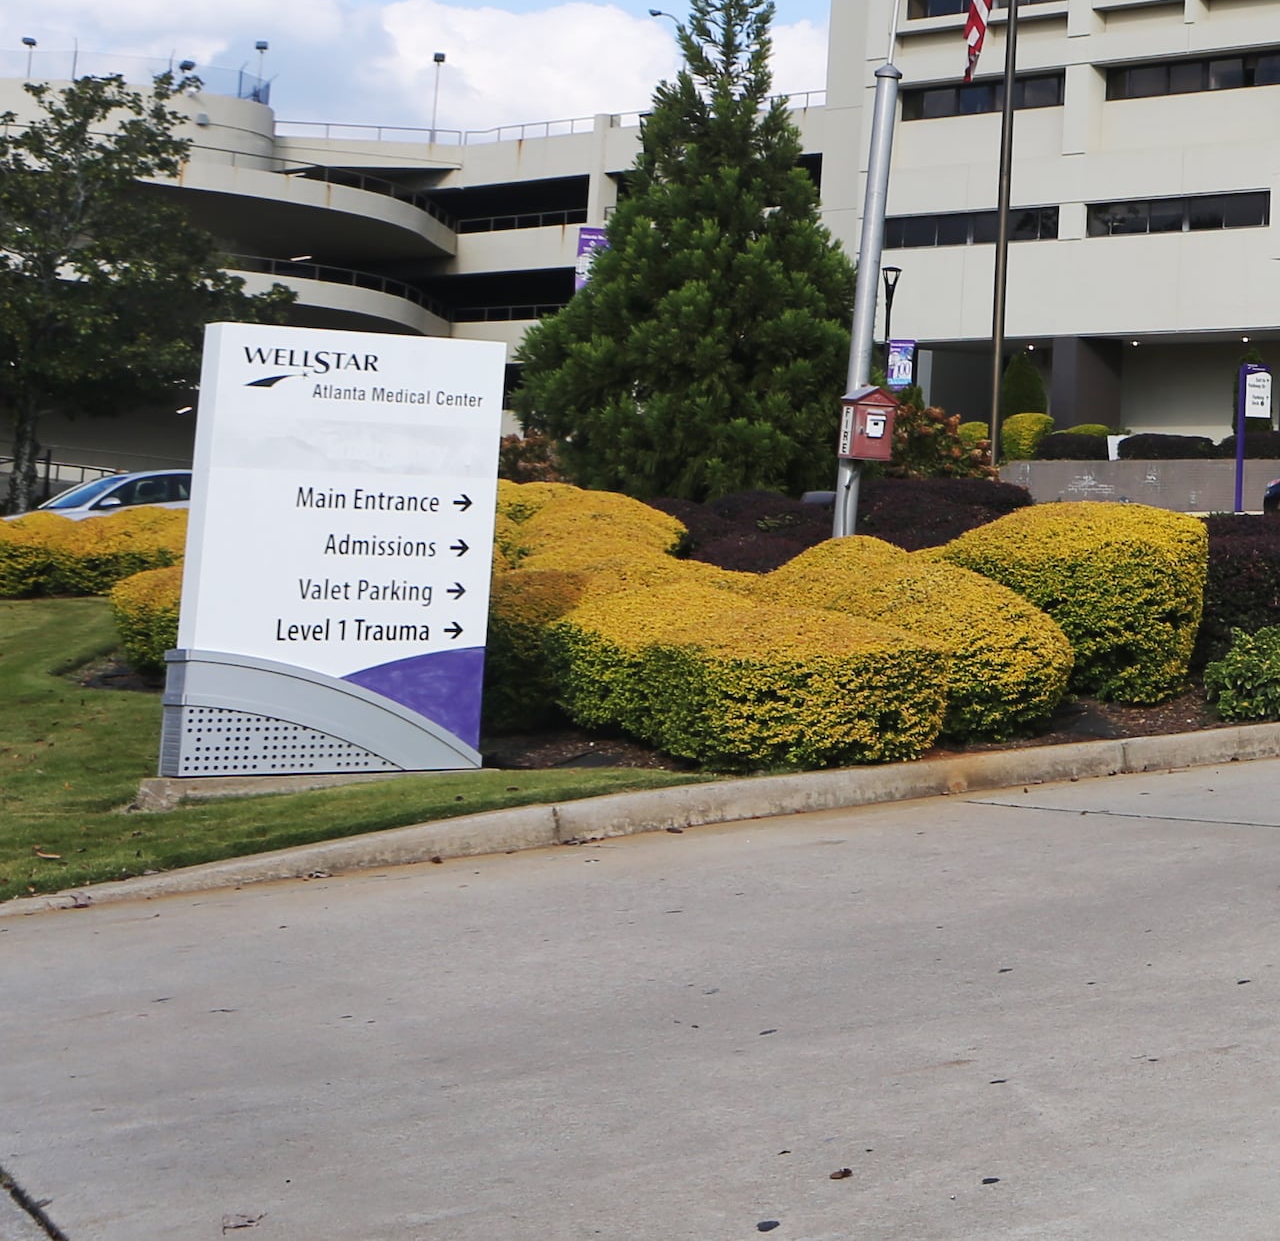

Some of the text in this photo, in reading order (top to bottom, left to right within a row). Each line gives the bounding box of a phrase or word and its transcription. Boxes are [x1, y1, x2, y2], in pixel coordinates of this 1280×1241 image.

[243, 346, 379, 374] WELLSTAR
[312, 383, 483, 408] Atlanta Medical Center
[842, 407, 851, 454] FIRE
[296, 486, 440, 512] Main Entrance
[324, 533, 437, 557] Admissions
[299, 578, 433, 607] Valet Parking
[276, 618, 430, 641] Level 1 Trauma
